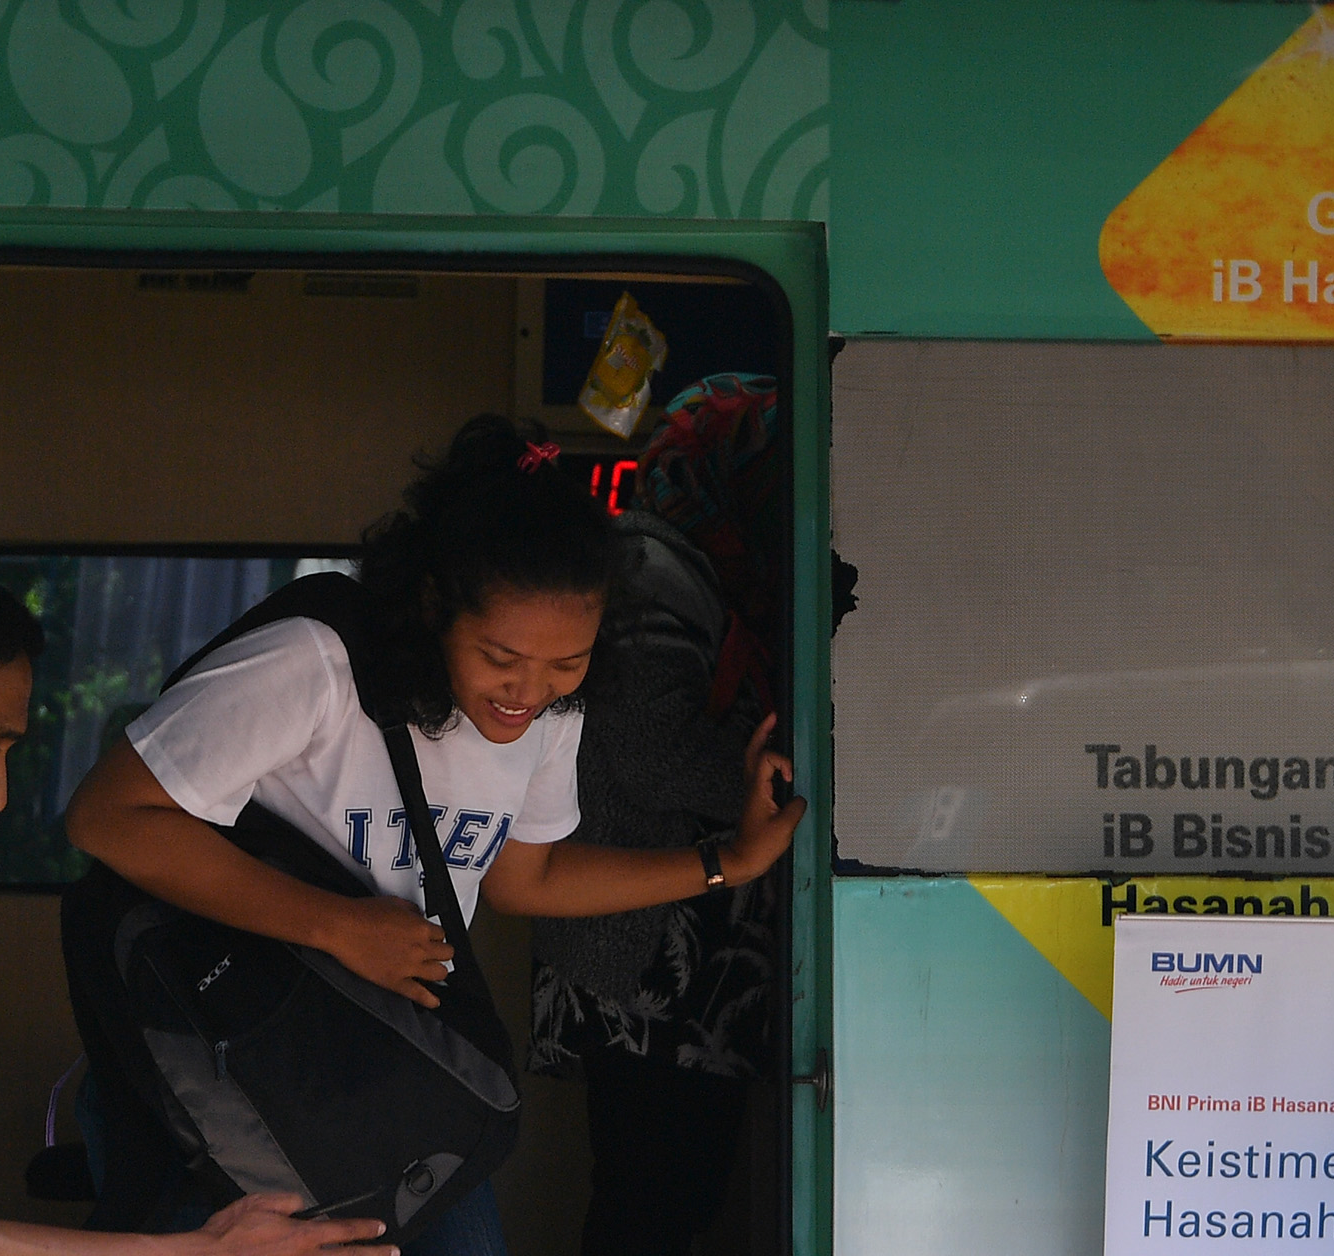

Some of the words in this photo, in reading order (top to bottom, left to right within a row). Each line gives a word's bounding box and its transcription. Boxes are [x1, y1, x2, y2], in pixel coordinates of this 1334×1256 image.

[1211, 259, 1263, 303] iB
[1102, 812, 1155, 859] iB
[1172, 813, 1332, 859] Bisnis
[196, 953, 232, 991] acer
[1151, 952, 1263, 974] BUMN
[1159, 974, 1188, 986] Hadir
[1189, 974, 1219, 986] untuk
[1220, 974, 1254, 989] negeri
[1147, 1094, 1181, 1112] BNI
[1187, 1095, 1241, 1113] Prima
[1246, 1096, 1266, 1113] iB
